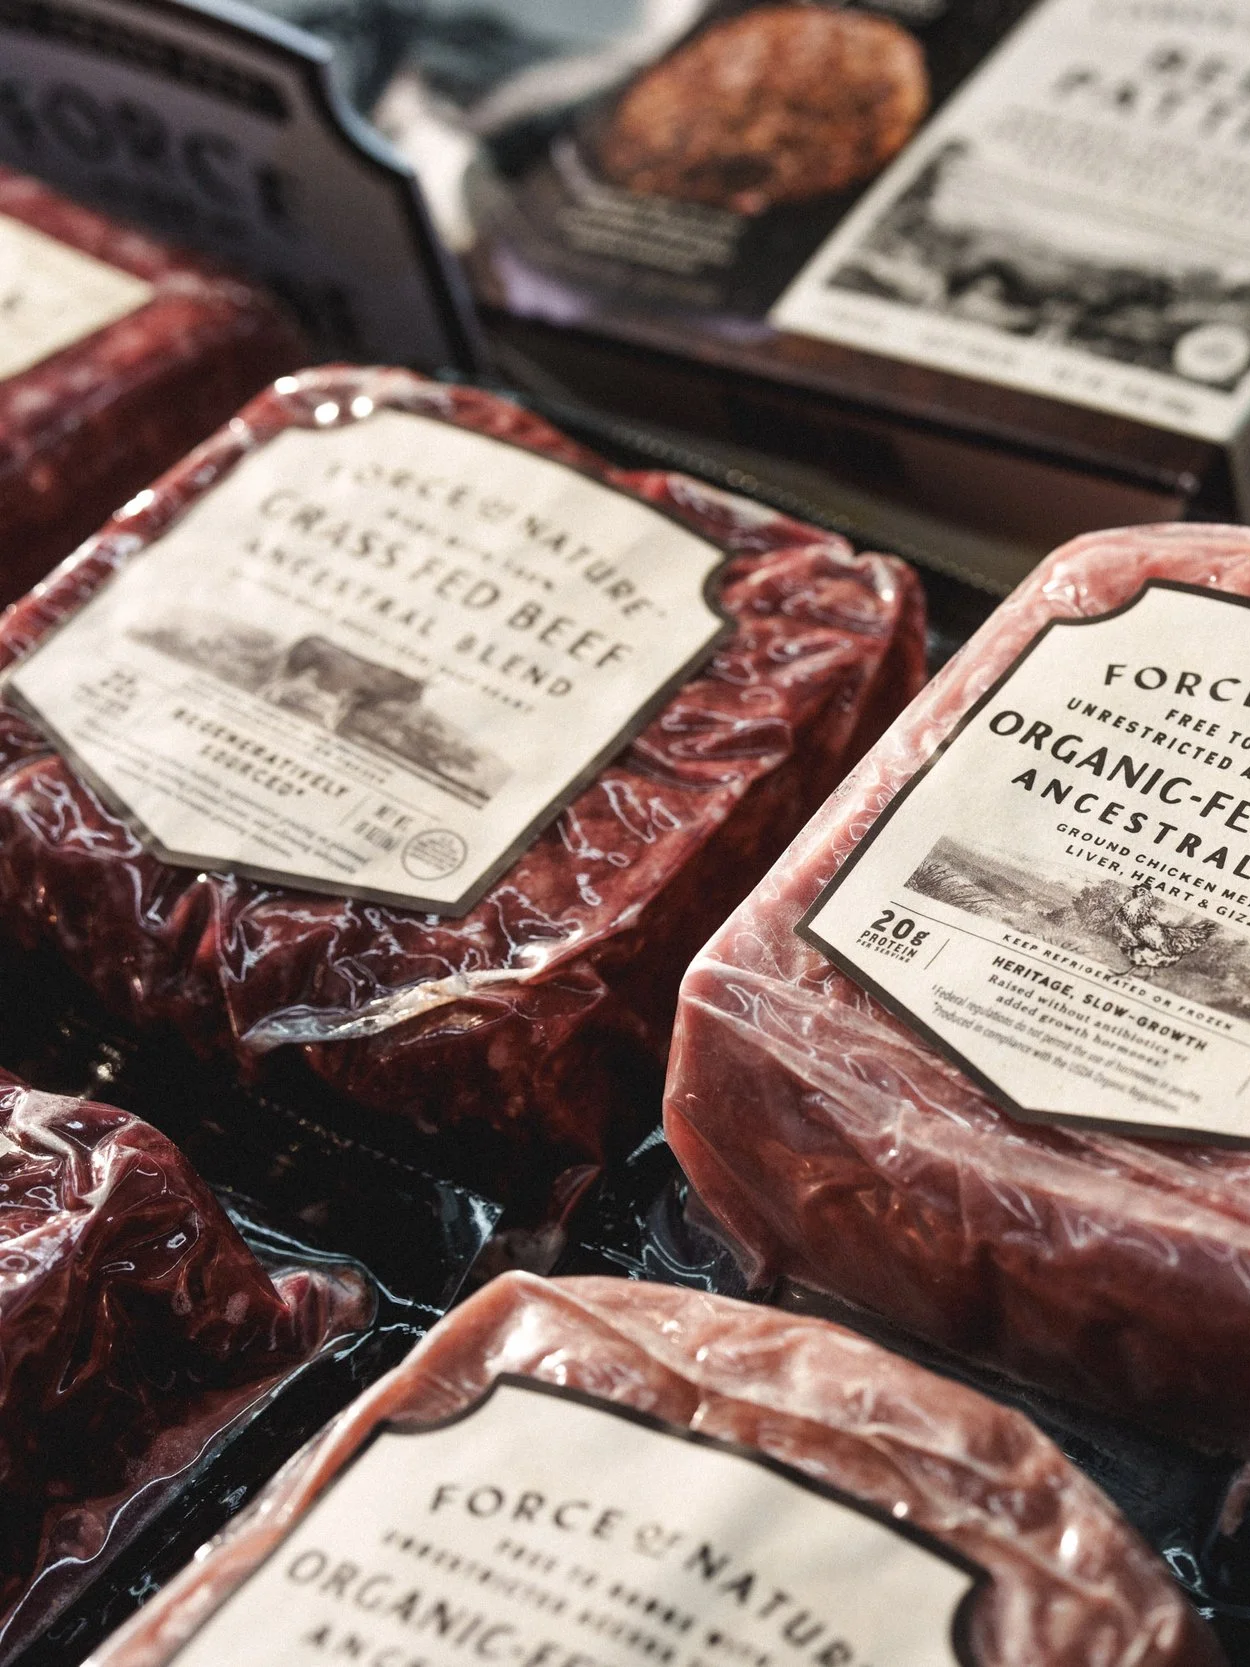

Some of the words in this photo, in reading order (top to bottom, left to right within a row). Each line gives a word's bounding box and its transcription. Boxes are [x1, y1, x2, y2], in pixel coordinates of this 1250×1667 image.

[407, 555, 502, 611] FED
[506, 600, 634, 671] BEEF
[454, 631, 574, 698] BLEND
[1066, 697, 1233, 770] UNRESTRICTED
[1165, 709, 1220, 737] FREE
[1056, 822, 1131, 857] GROUND
[1135, 853, 1217, 893] CHICKEN
[1065, 844, 1124, 876] LIVER,
[1130, 869, 1195, 902] HEART
[1197, 898, 1209, 909] &
[856, 938, 872, 949] PER
[873, 944, 911, 964] SERVING
[860, 929, 919, 959] PROTEIN
[870, 909, 931, 947] 20g
[988, 973, 1036, 999] Raised
[1037, 995, 1091, 1024] without
[1093, 1018, 1170, 1055] antibiotics
[992, 955, 1075, 1000] HERITAGE,
[1082, 994, 1209, 1052] SLOW-GROWTH
[1002, 933, 1038, 952] KEEP
[1043, 949, 1148, 997] REFRIGERATED
[1152, 995, 1172, 1008] OR
[1178, 1005, 1234, 1031] FROZEN
[996, 994, 1037, 1018] added
[1039, 1012, 1089, 1040] growth
[429, 1484, 625, 1540] FORCE
[683, 1540, 868, 1667] NATUR
